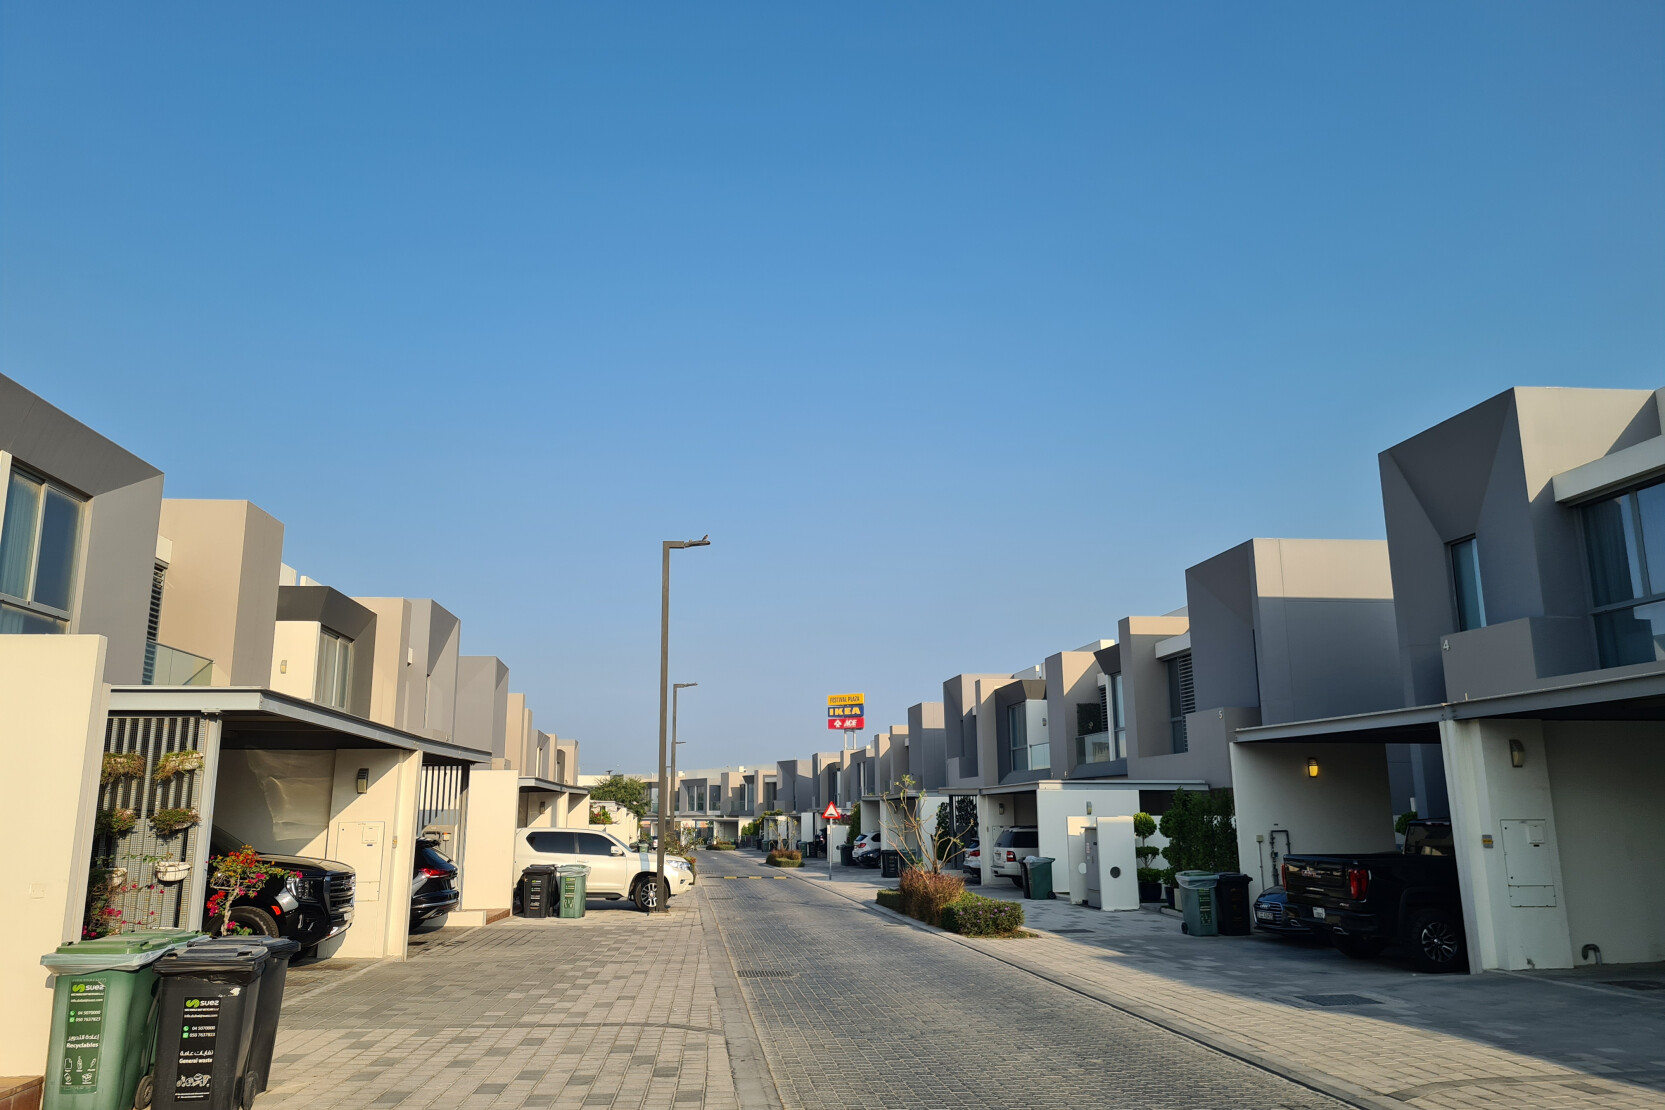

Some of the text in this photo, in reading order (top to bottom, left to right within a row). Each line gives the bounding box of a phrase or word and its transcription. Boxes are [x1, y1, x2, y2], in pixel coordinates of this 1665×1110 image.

[1443, 639, 1449, 651] 4
[829, 707, 861, 716] IKEA
[844, 719, 858, 728] ACE
[66, 1042, 99, 1050] Recyclables
